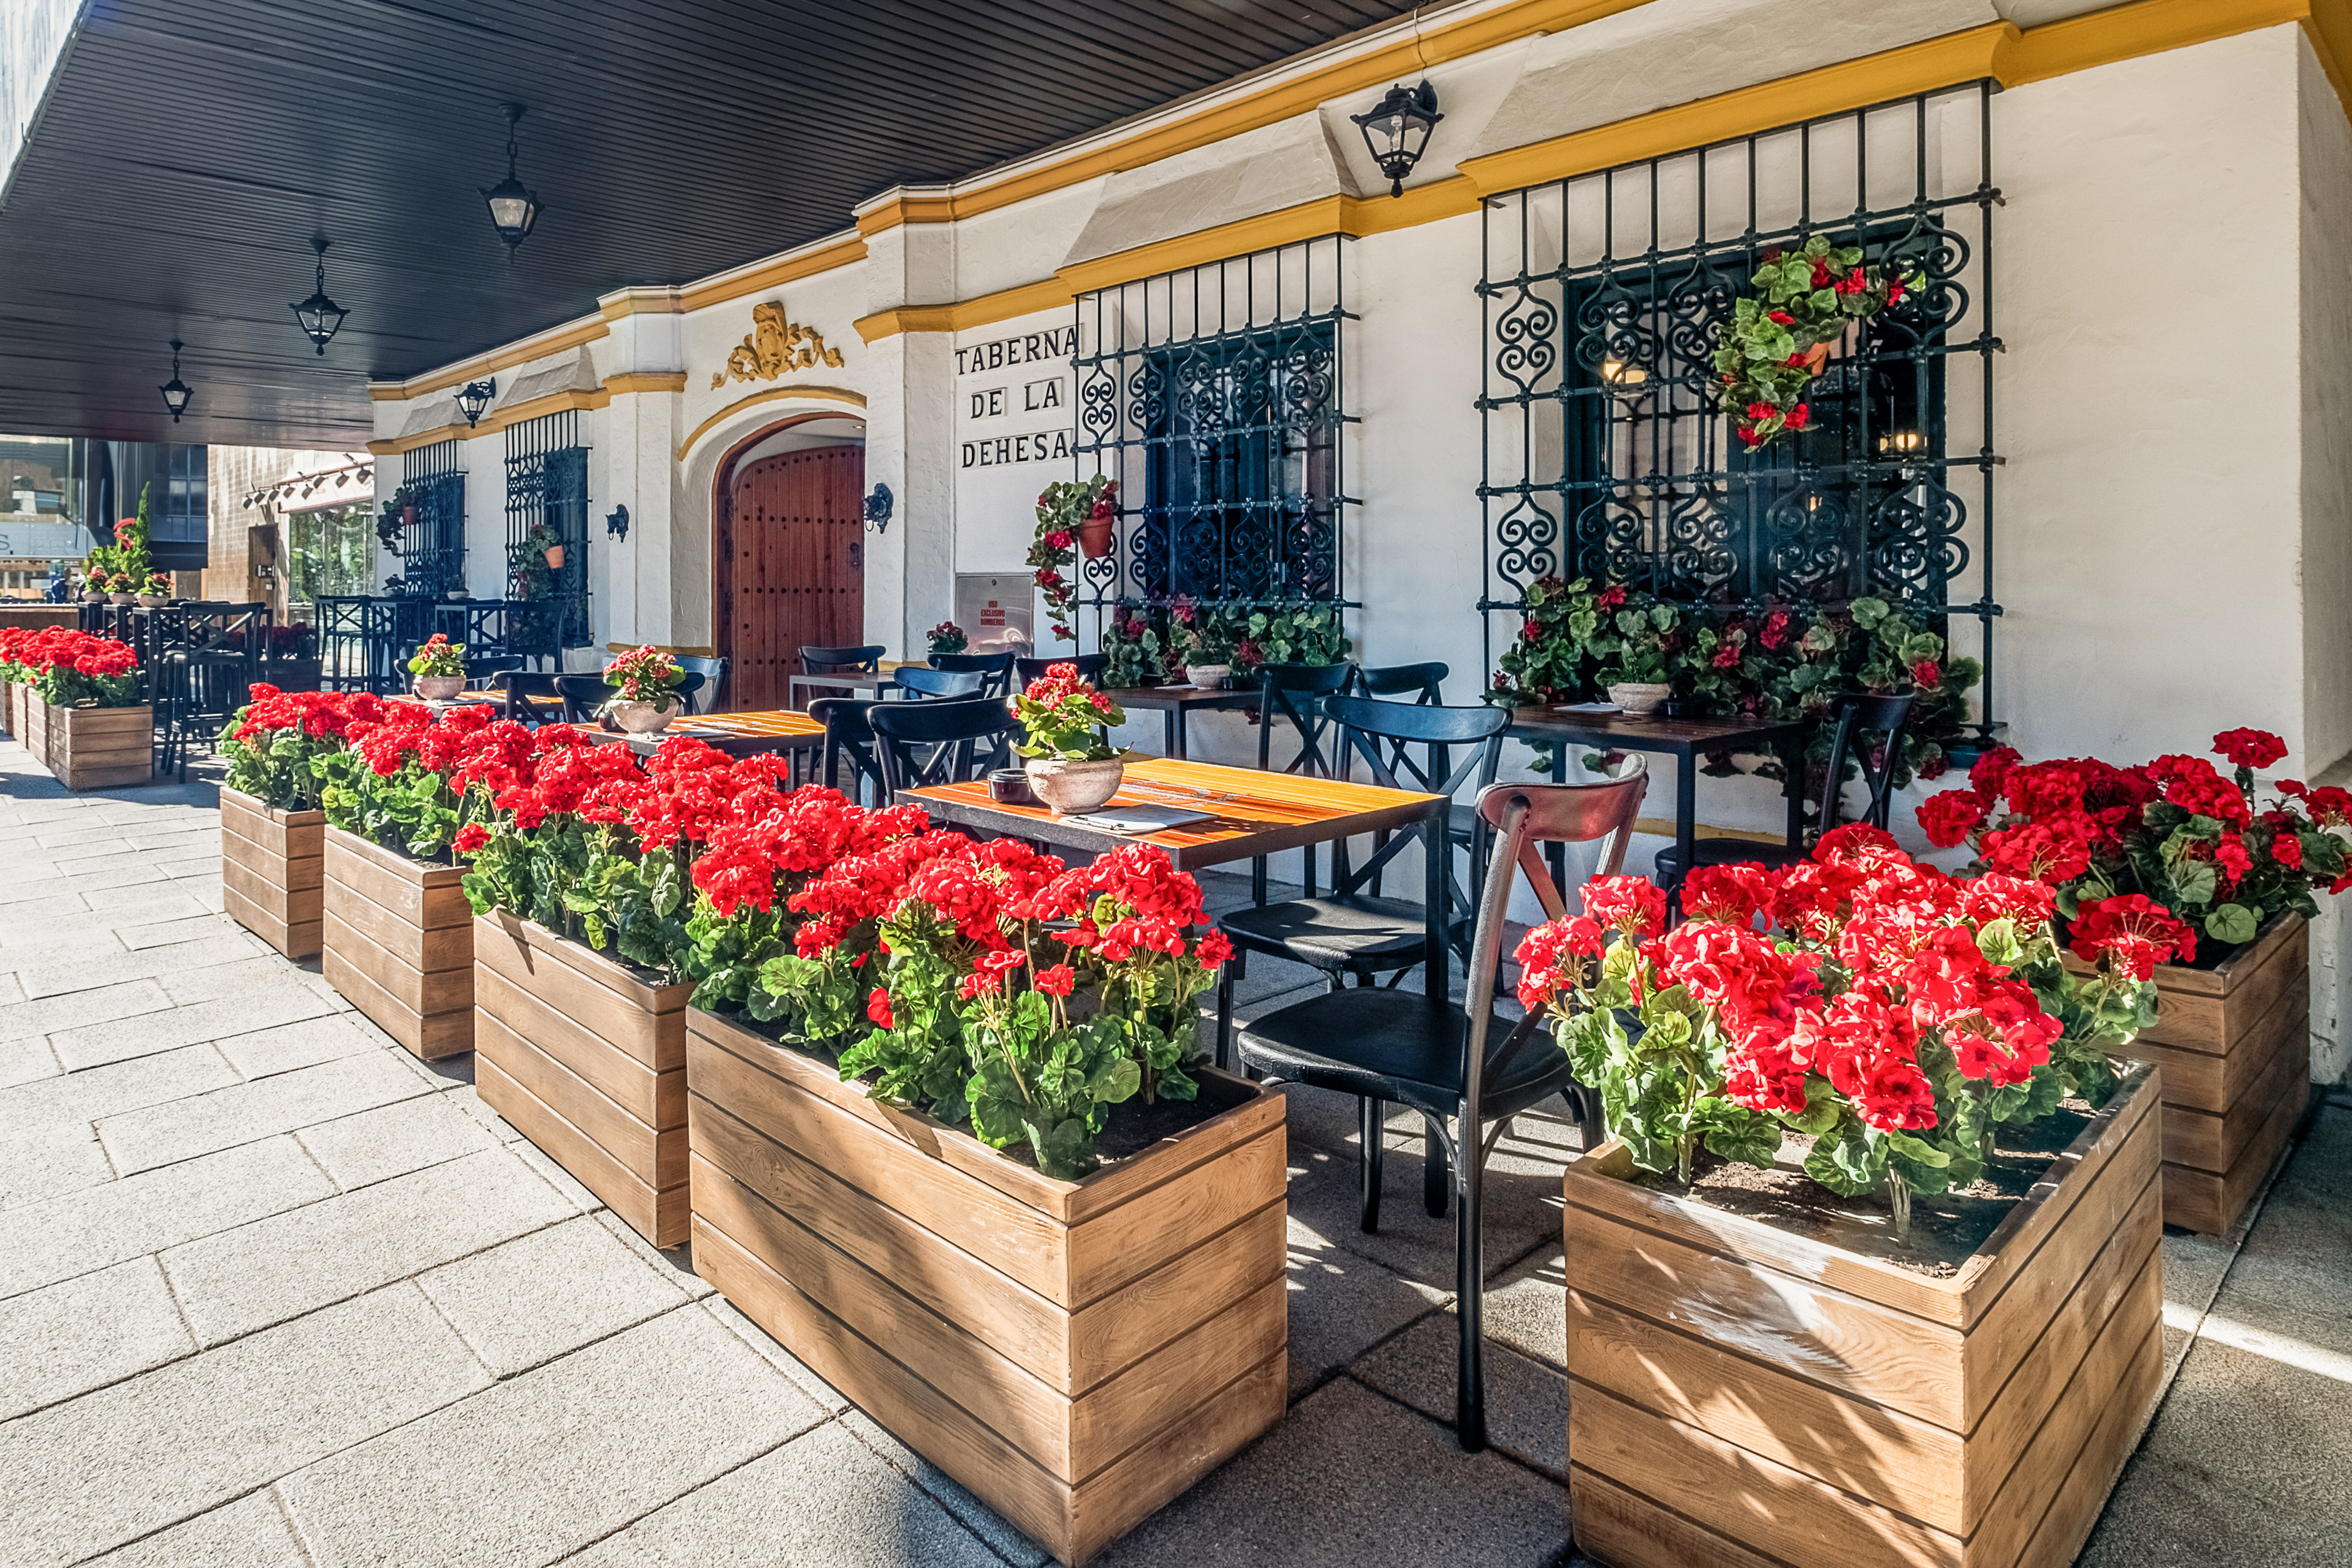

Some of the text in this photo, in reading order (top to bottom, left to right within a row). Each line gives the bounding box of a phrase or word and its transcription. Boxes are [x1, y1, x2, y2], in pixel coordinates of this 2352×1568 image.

[955, 327, 1079, 375] TABERNA
[971, 381, 1059, 419] DE LA
[962, 432, 1069, 468] DEHESA
[980, 618, 1005, 626] BOMBEROS
